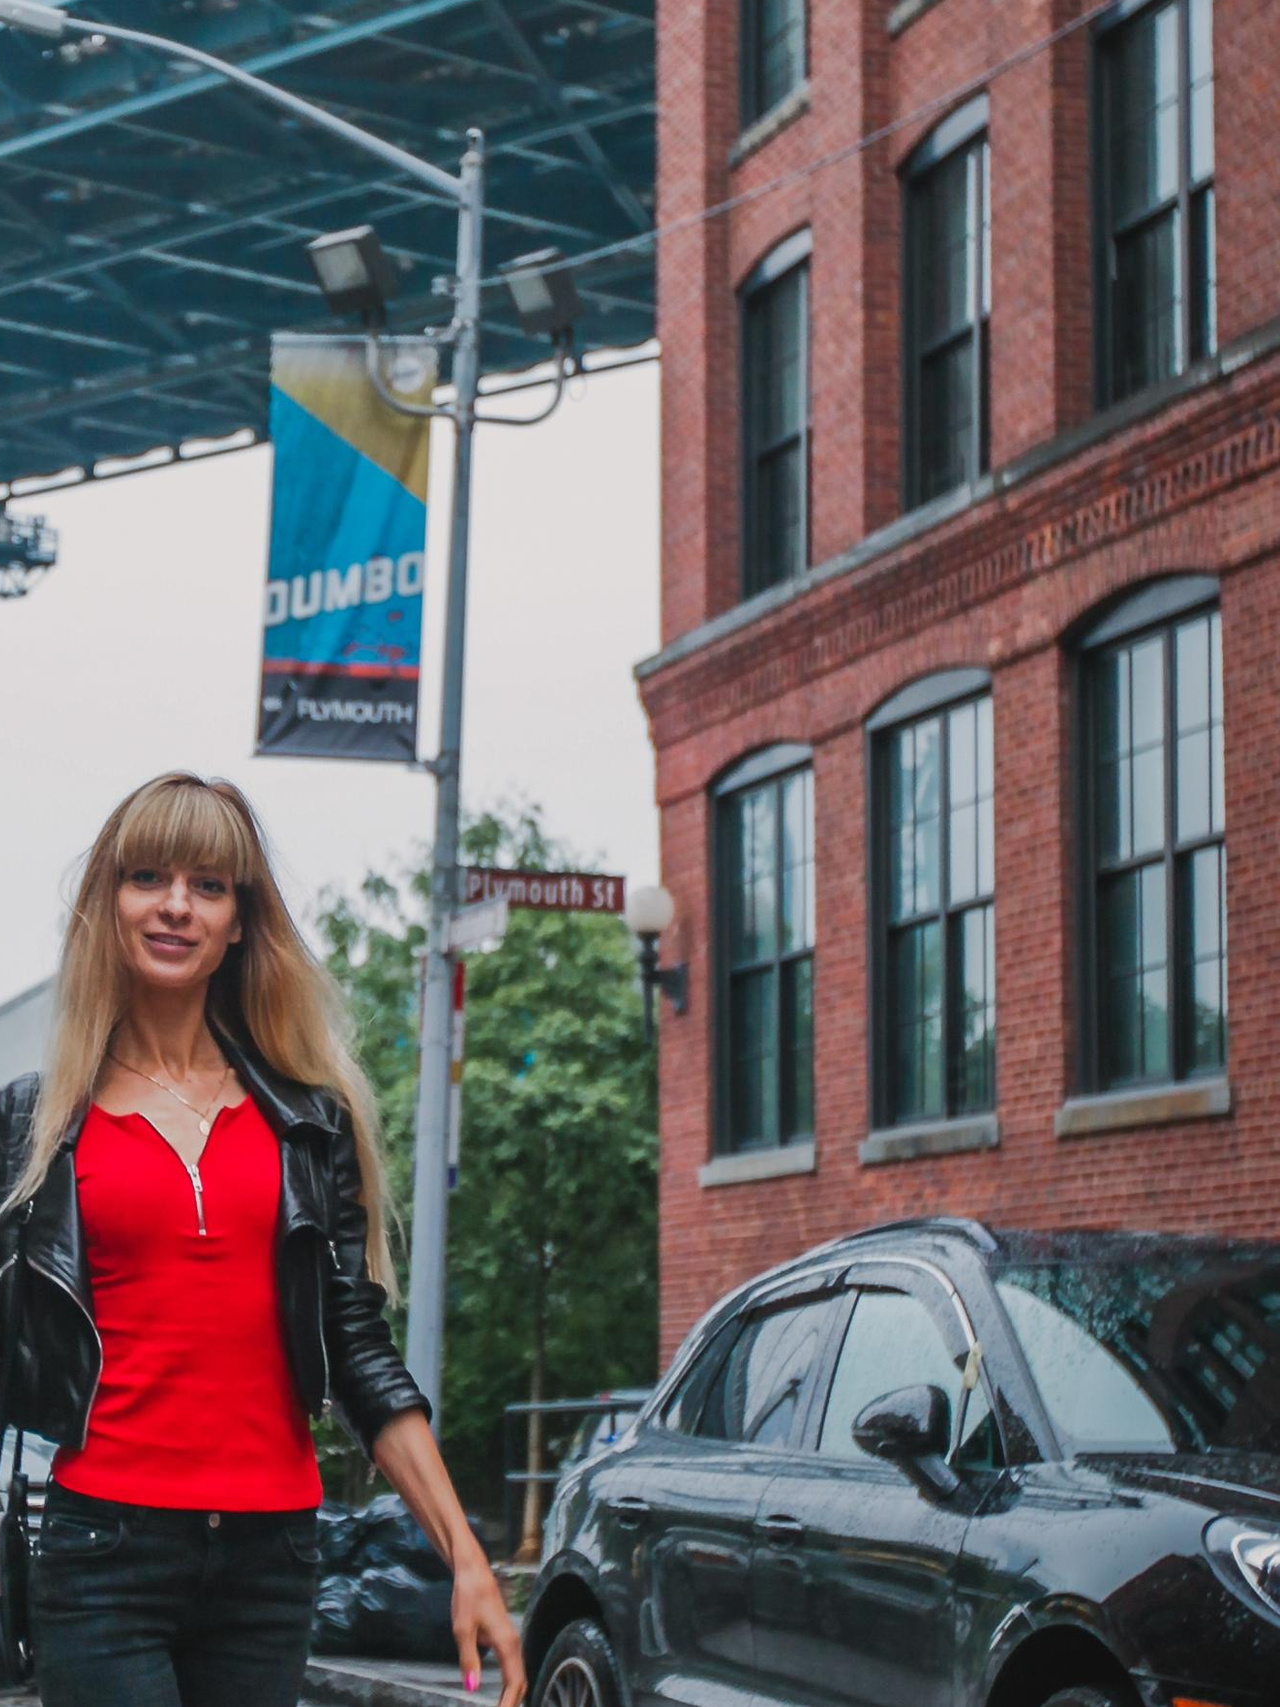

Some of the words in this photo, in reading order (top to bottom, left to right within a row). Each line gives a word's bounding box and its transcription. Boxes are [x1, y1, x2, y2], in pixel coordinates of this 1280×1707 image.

[265, 551, 425, 627] DUMBO
[297, 698, 413, 724] PLYMOUTH
[470, 872, 584, 906] Plymouth
[592, 879, 615, 909] St
